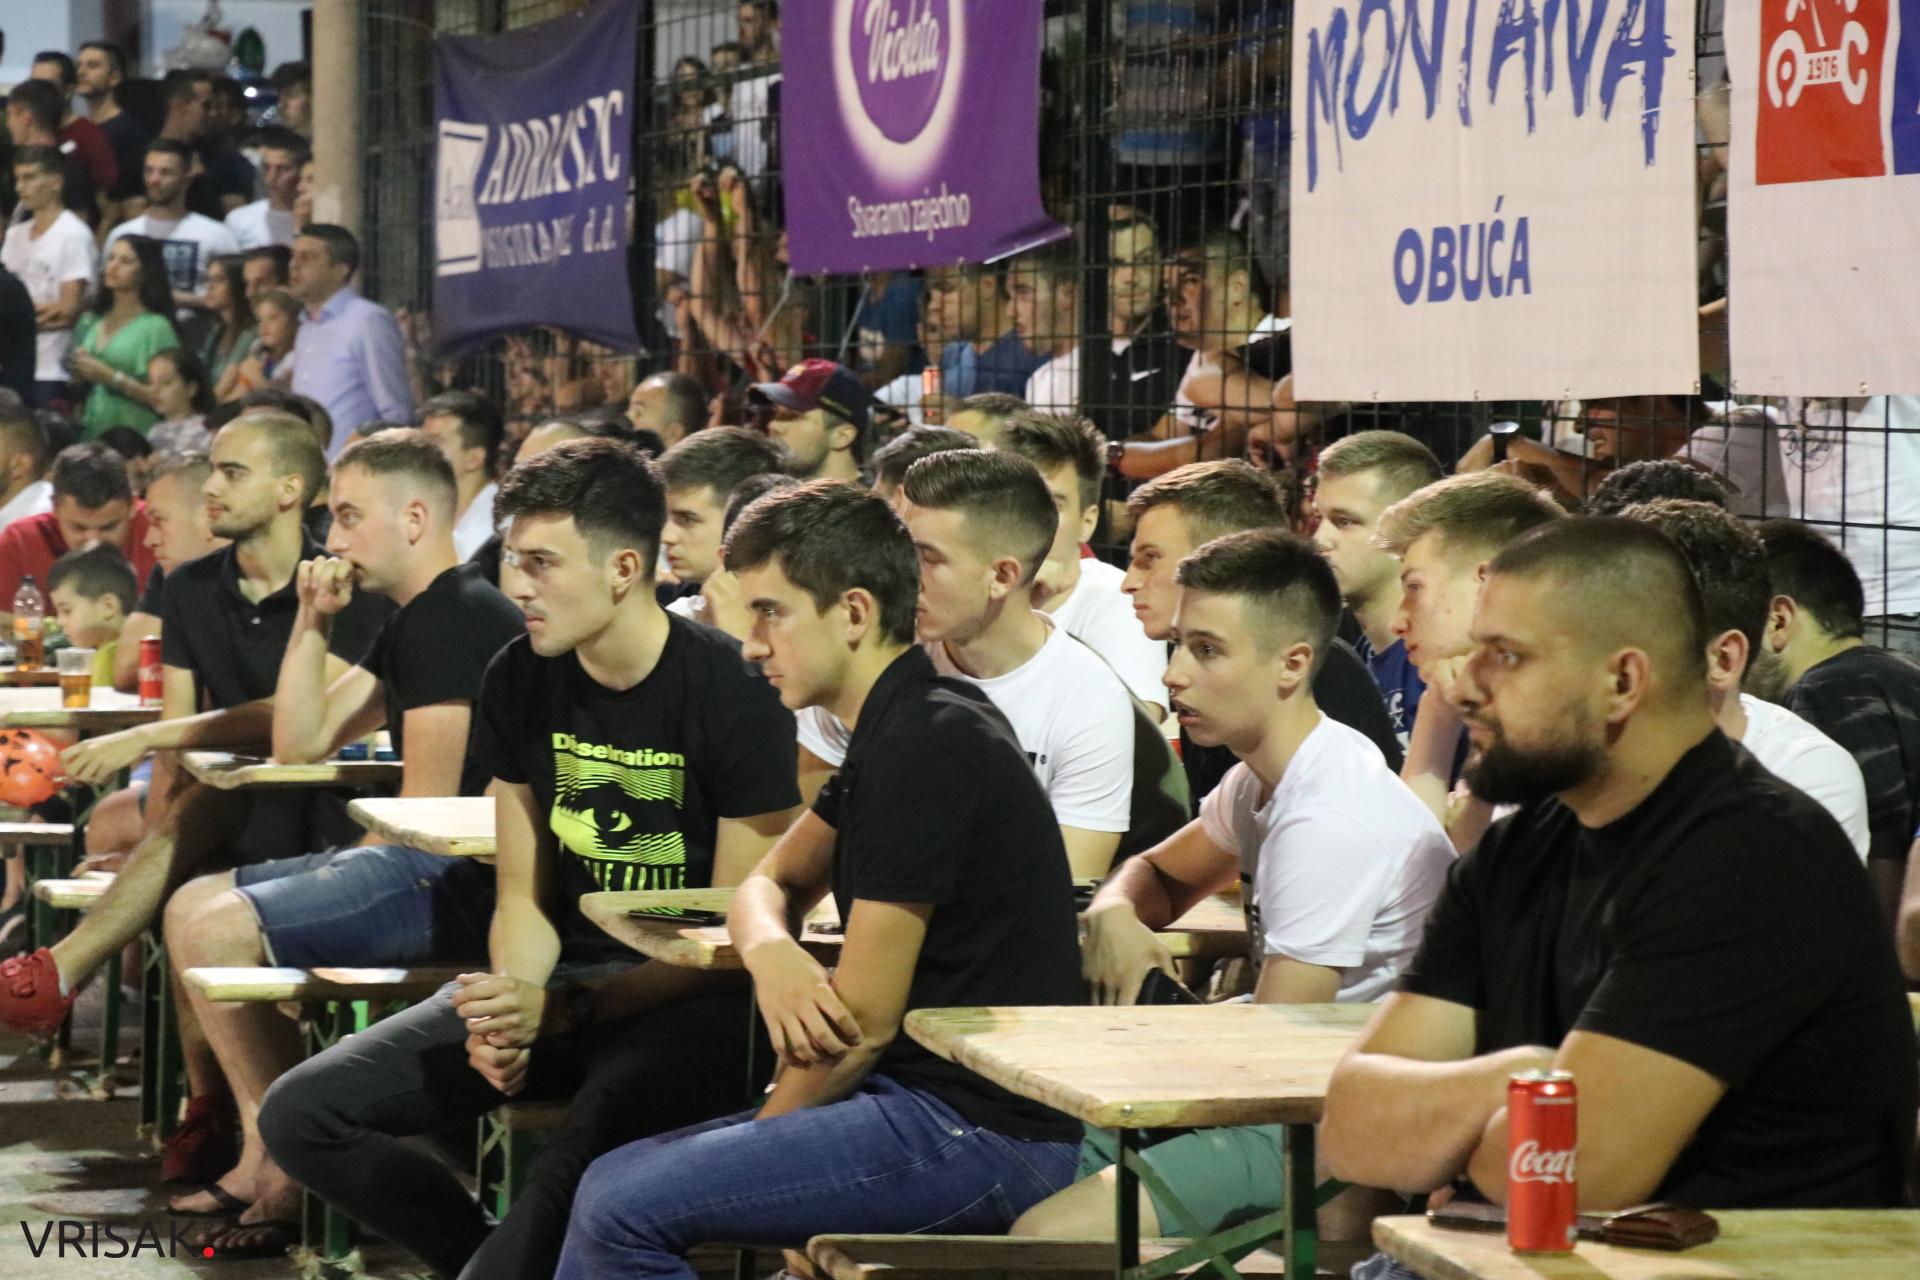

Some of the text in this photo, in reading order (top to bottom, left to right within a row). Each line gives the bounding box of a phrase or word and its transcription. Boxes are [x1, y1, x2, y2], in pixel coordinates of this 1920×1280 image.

[1806, 56, 1838, 80] 1976
[909, 182, 971, 242] zajedno
[1394, 195, 1531, 305] OBUĆA
